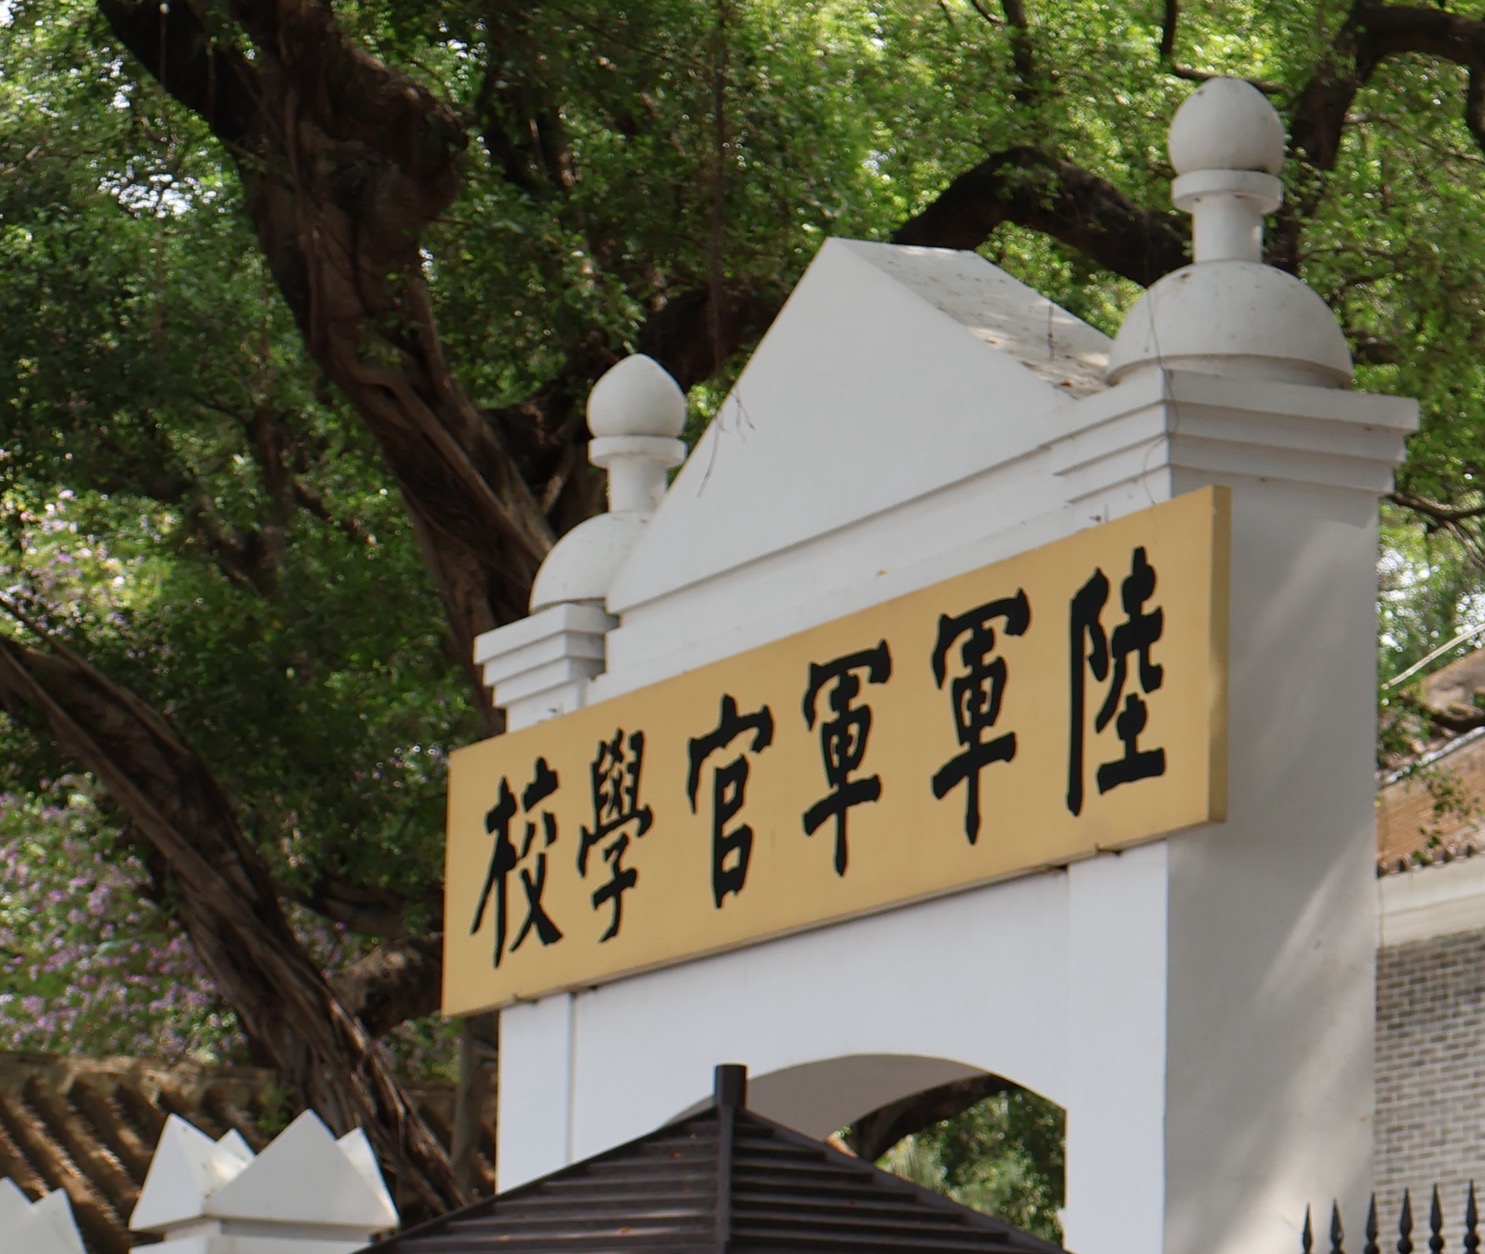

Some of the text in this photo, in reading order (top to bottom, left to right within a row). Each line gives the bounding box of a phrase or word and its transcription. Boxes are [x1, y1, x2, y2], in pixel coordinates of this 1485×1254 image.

[470, 545, 1167, 970] 陸軍軍官學校
